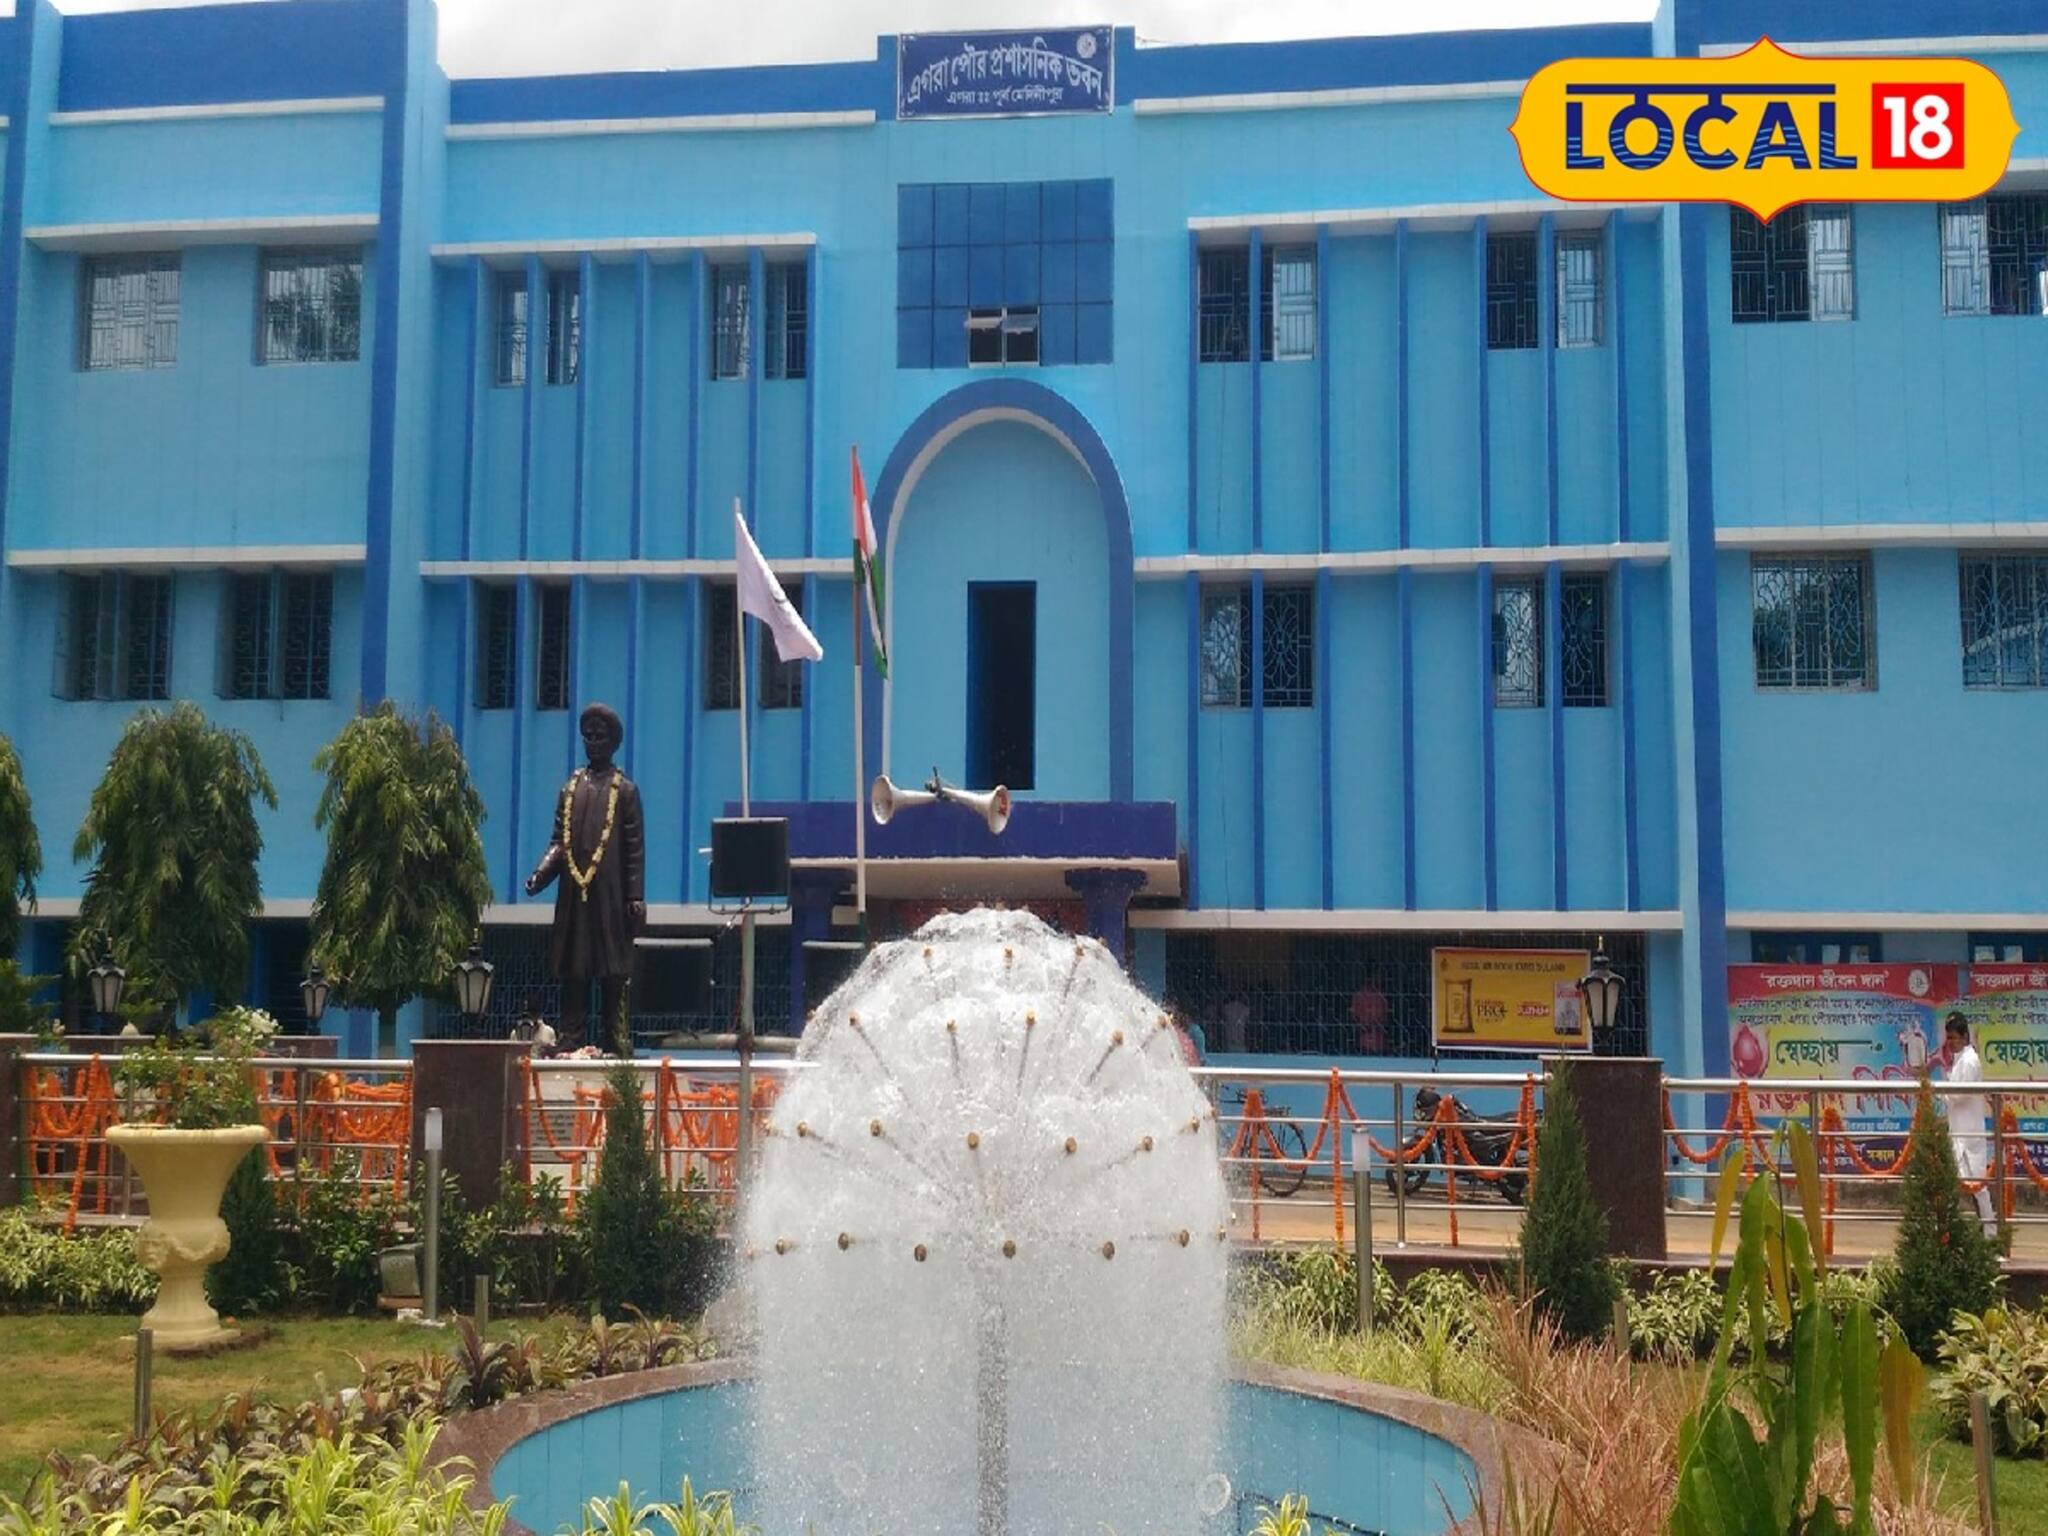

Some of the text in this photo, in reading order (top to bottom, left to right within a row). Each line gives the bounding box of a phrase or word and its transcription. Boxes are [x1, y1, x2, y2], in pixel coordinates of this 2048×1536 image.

[908, 36, 1104, 103] এগরা পৌর প্রশাসনিক ভবন
[1818, 968, 1857, 988] জীবন
[1777, 1036, 1840, 1067] স্বেচ্ছায়
